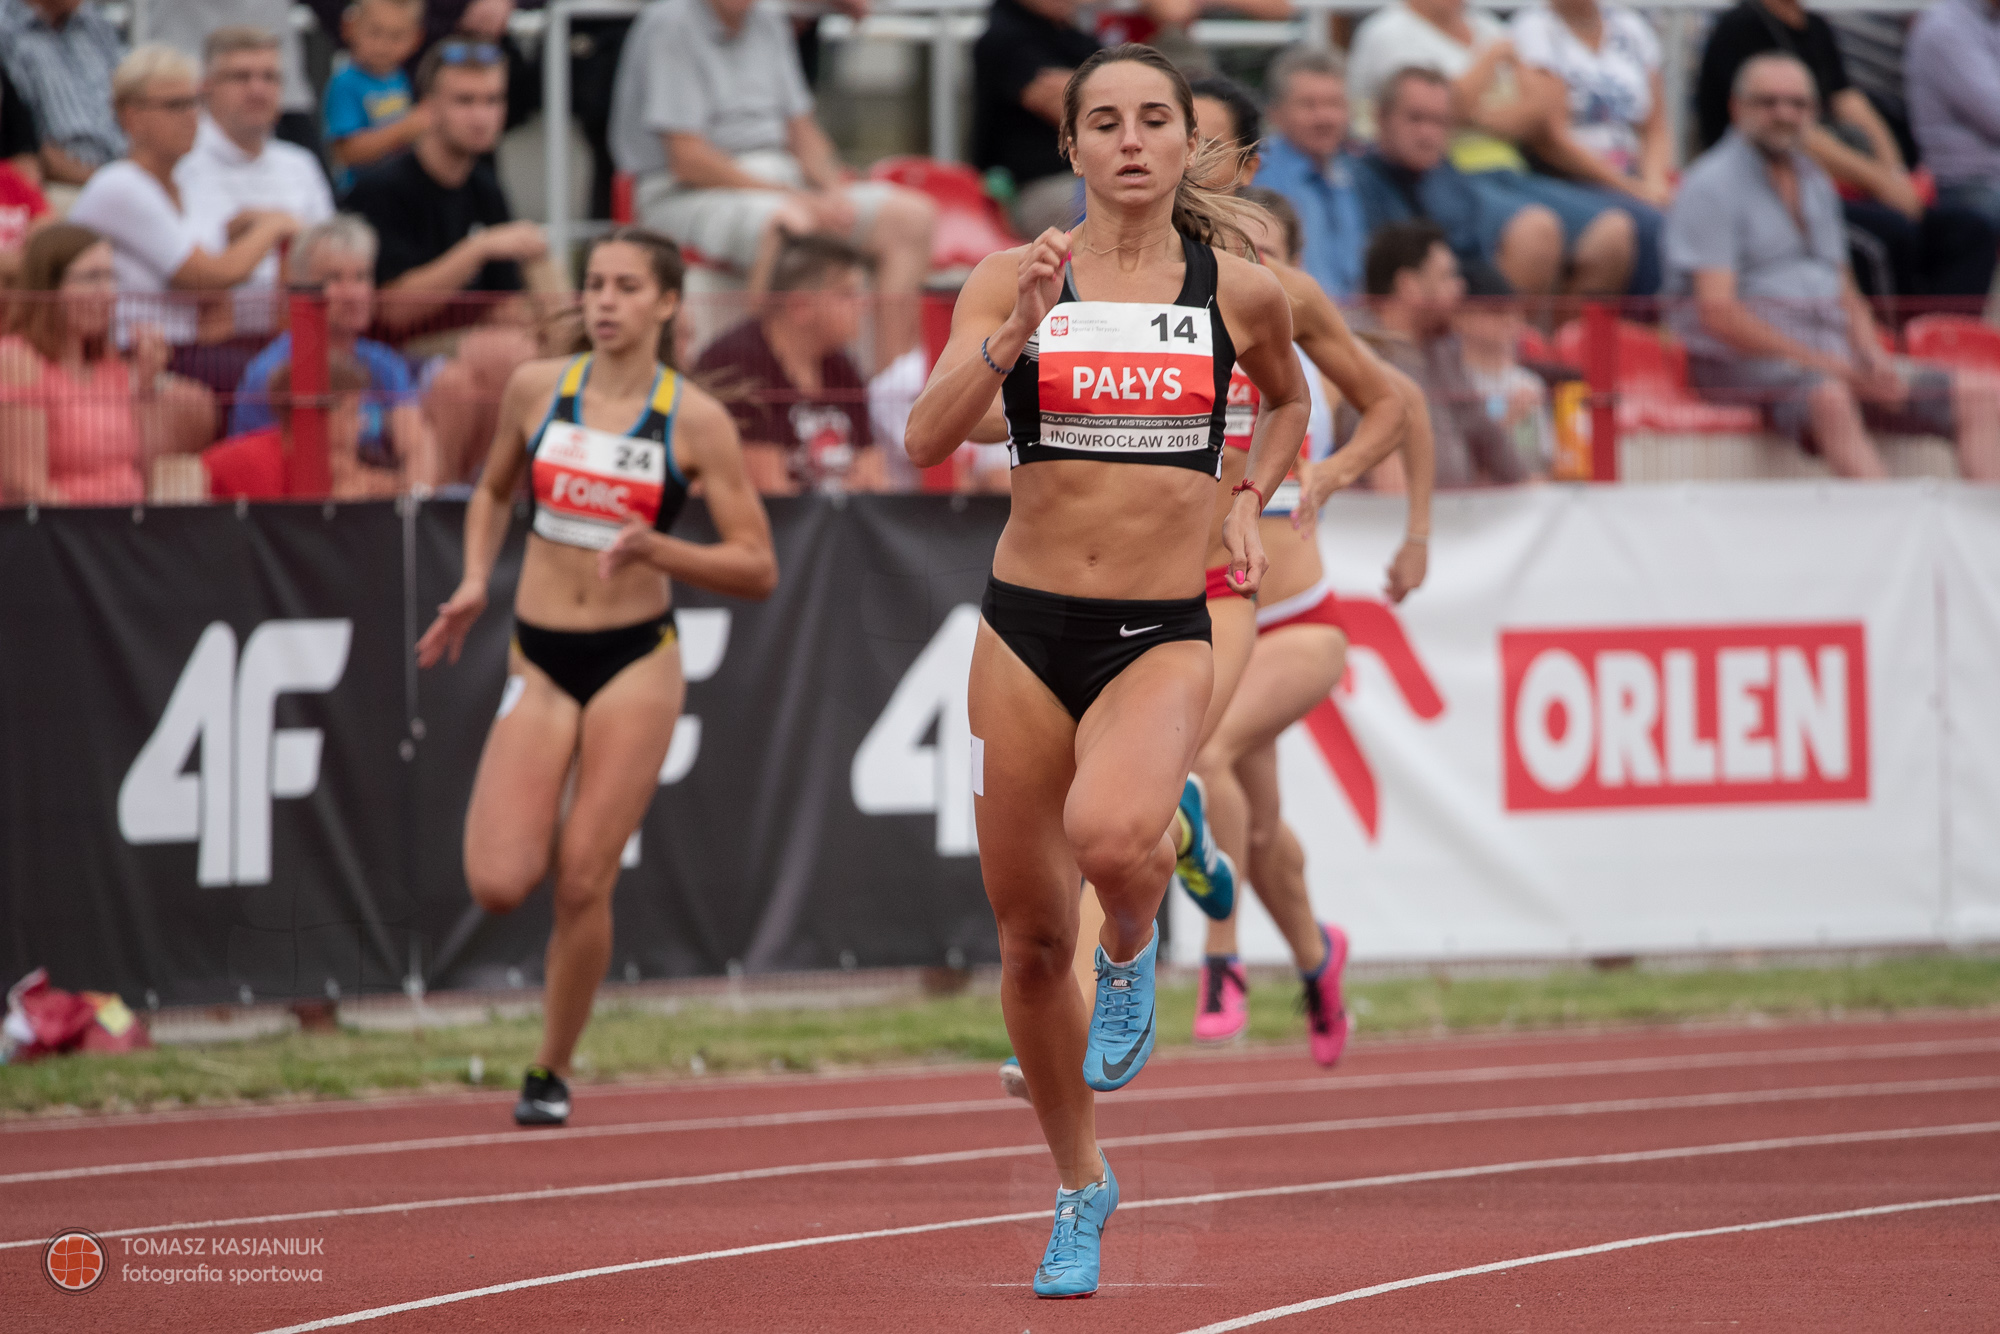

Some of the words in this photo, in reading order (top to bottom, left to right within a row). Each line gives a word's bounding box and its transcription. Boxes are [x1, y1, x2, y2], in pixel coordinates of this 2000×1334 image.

[1151, 313, 1198, 343] 14
[1072, 366, 1182, 400] PAŁYS
[1041, 414, 1063, 423] PZLA
[1064, 416, 1118, 426] DRUŻYNOWE
[1119, 419, 1182, 427] MISTRZOSTWA
[1182, 417, 1210, 427] POLSKI
[1050, 430, 1163, 448] INOWROCŁAW
[1167, 433, 1199, 448] 2018
[616, 445, 651, 471] 24
[1513, 643, 1852, 794] ORLEN
[117, 617, 353, 887] 4F
